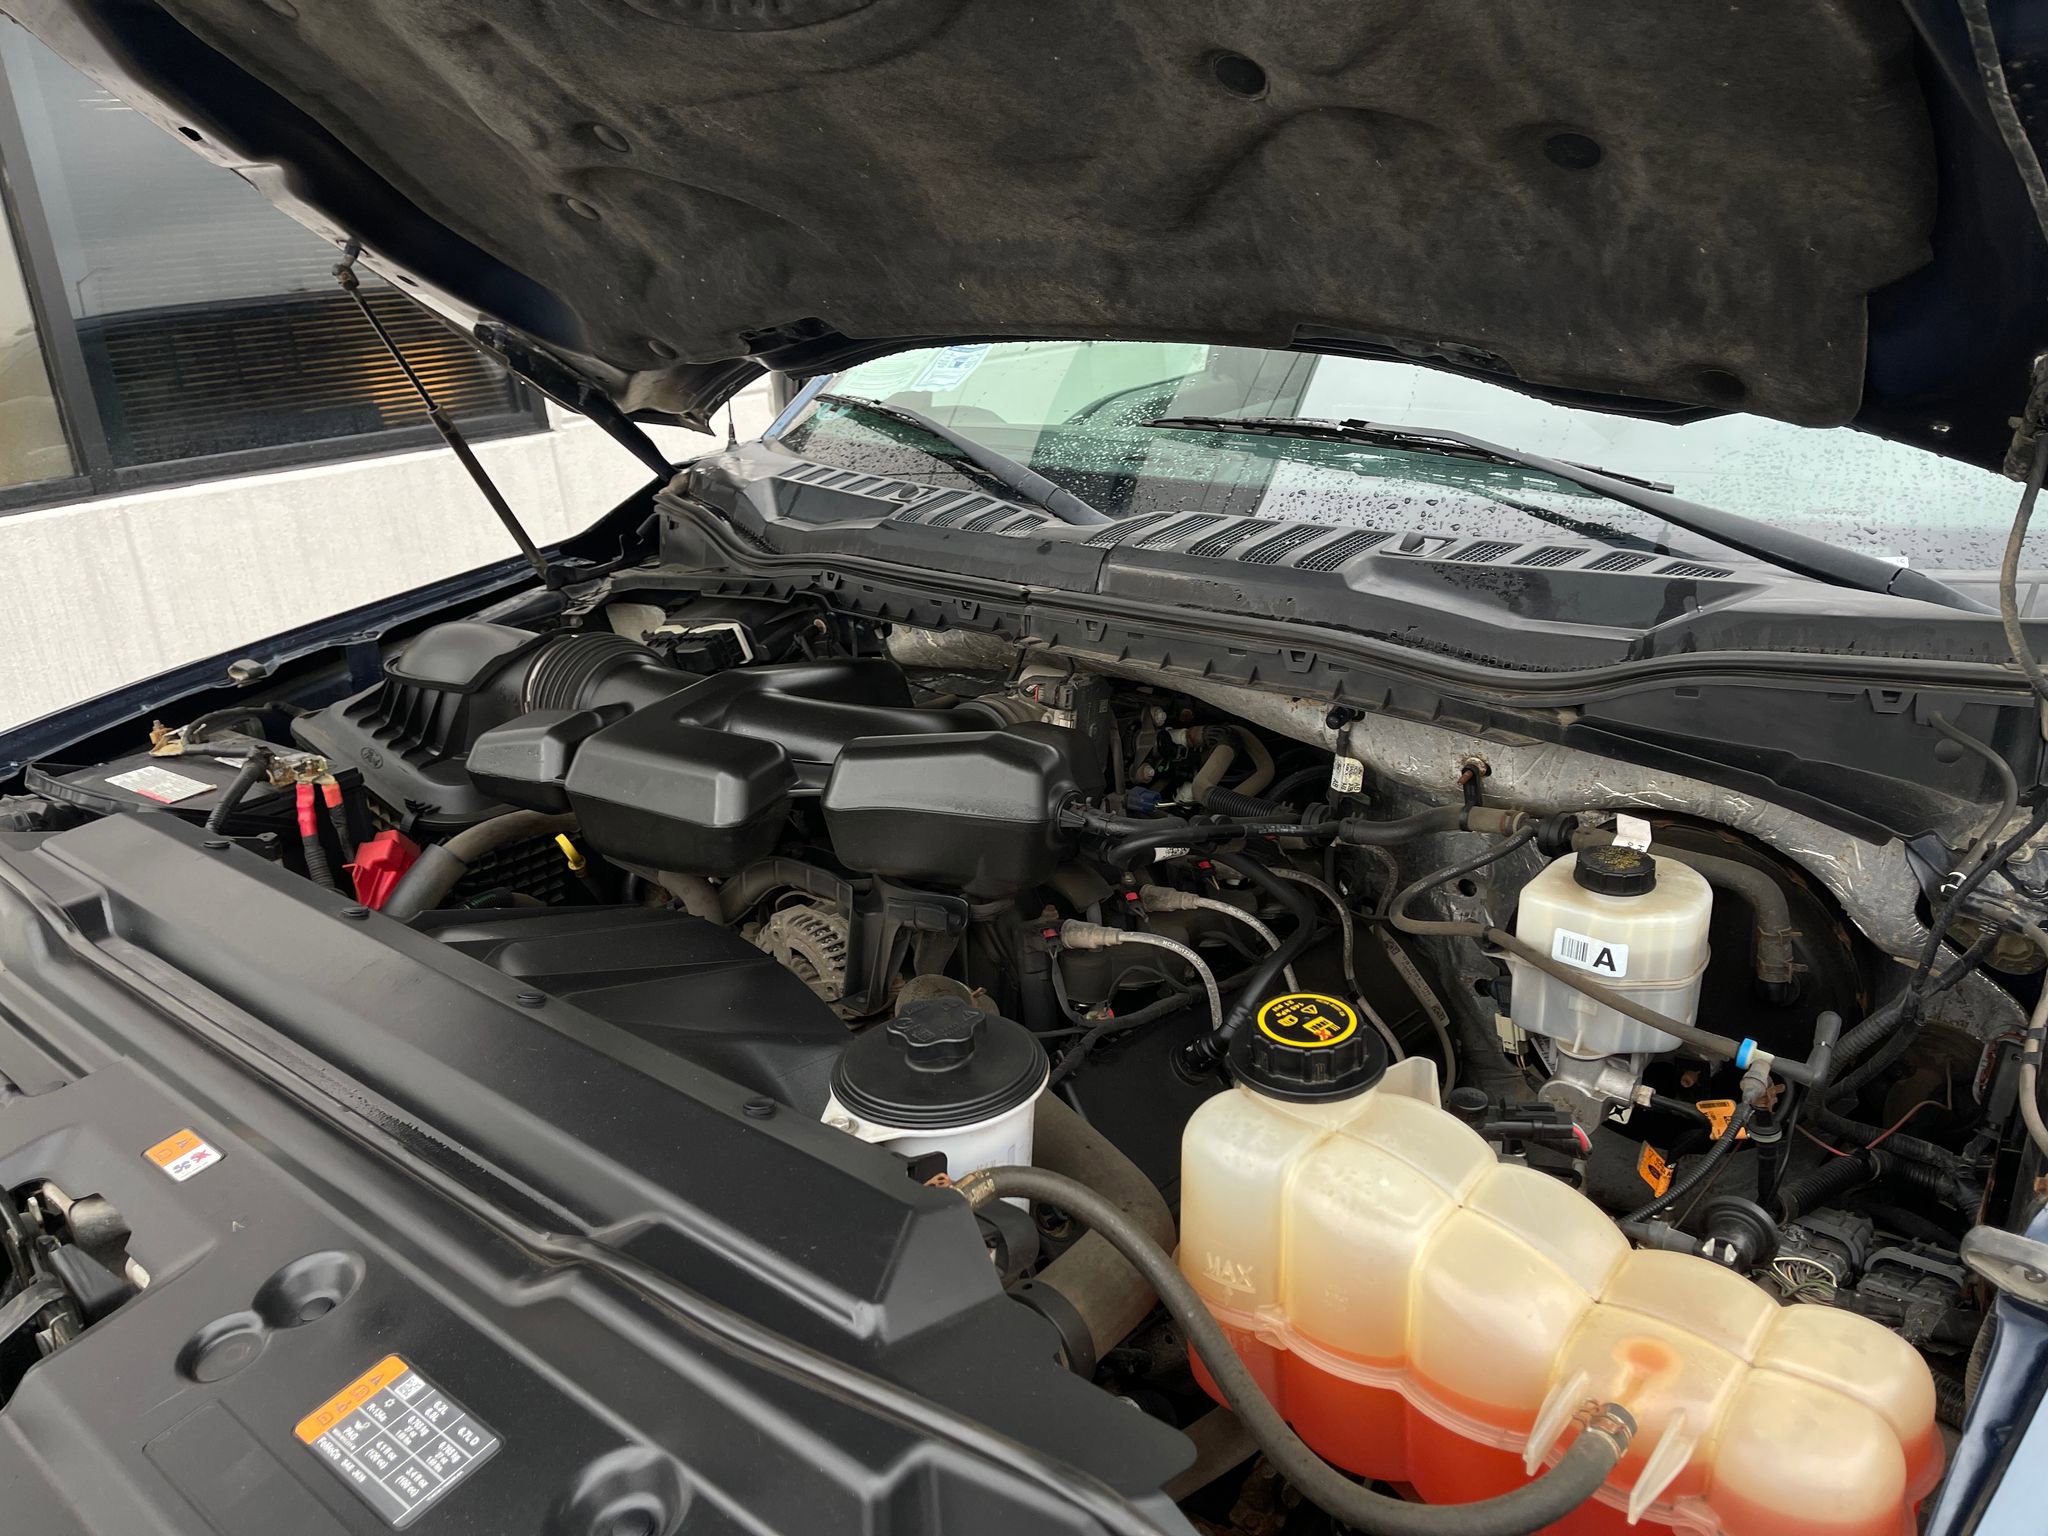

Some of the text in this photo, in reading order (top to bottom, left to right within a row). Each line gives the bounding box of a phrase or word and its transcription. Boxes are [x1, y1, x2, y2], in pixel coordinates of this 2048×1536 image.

[1592, 947, 1616, 972] A
[1205, 1252, 1254, 1287] MAX
[341, 1426, 359, 1441] PAG
[469, 1435, 480, 1446] D
[316, 1436, 341, 1460] FoMoCo
[339, 1458, 355, 1472] SAE
